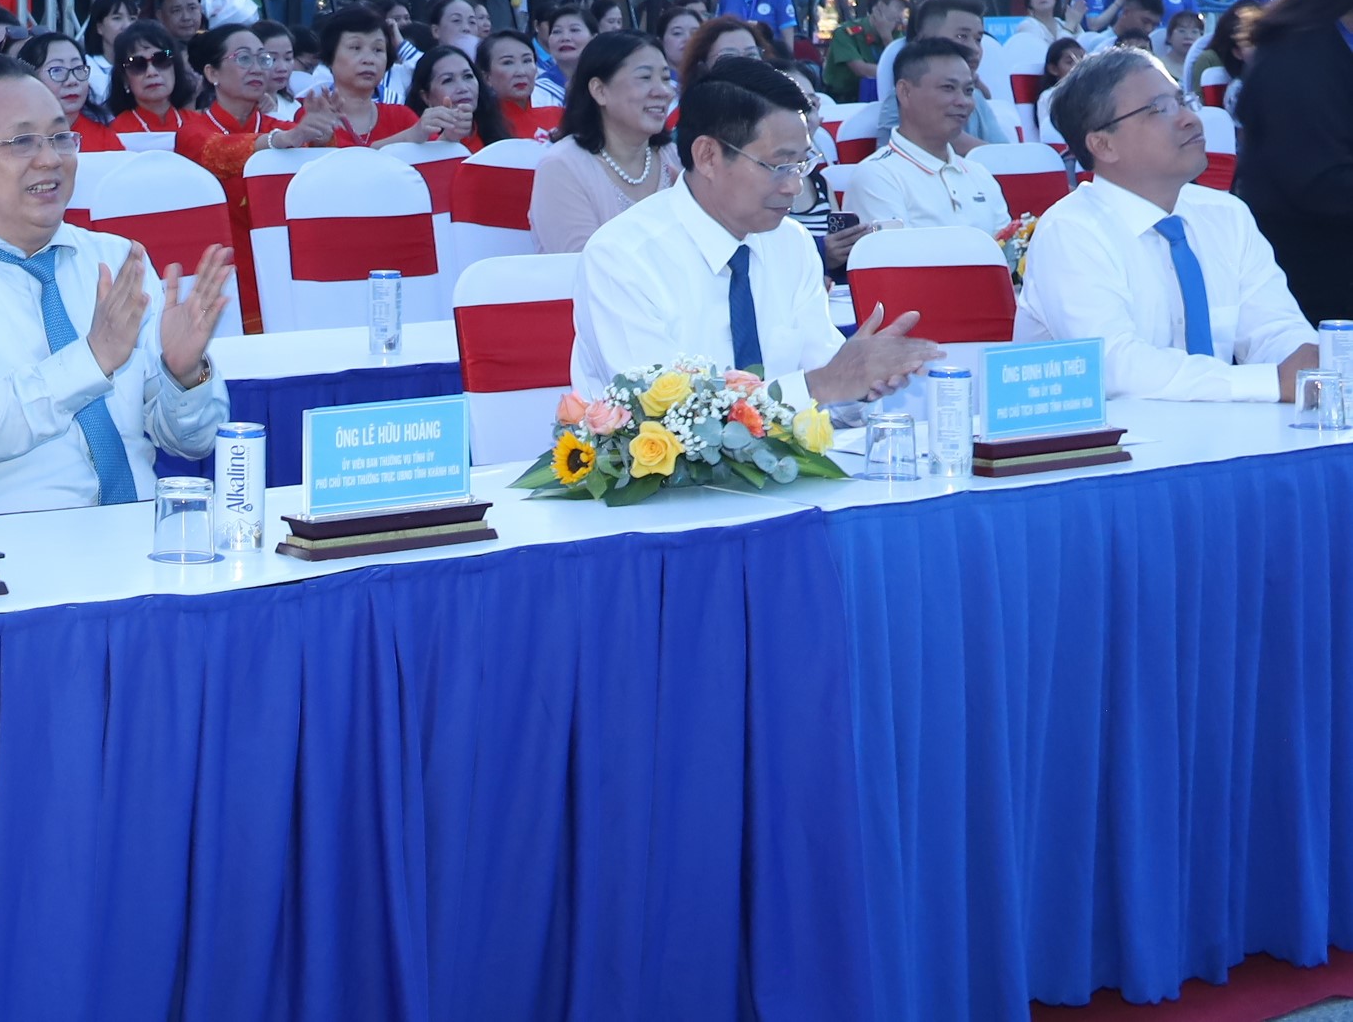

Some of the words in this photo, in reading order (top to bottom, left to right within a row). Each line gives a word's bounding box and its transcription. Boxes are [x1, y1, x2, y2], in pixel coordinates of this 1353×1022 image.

[336, 425, 359, 448] ÔNG
[362, 423, 375, 446] LÊ
[378, 422, 400, 444] HỮU
[404, 418, 441, 441] HOÀNG
[226, 444, 245, 514] Alkaline
[396, 469, 413, 481] UBND
